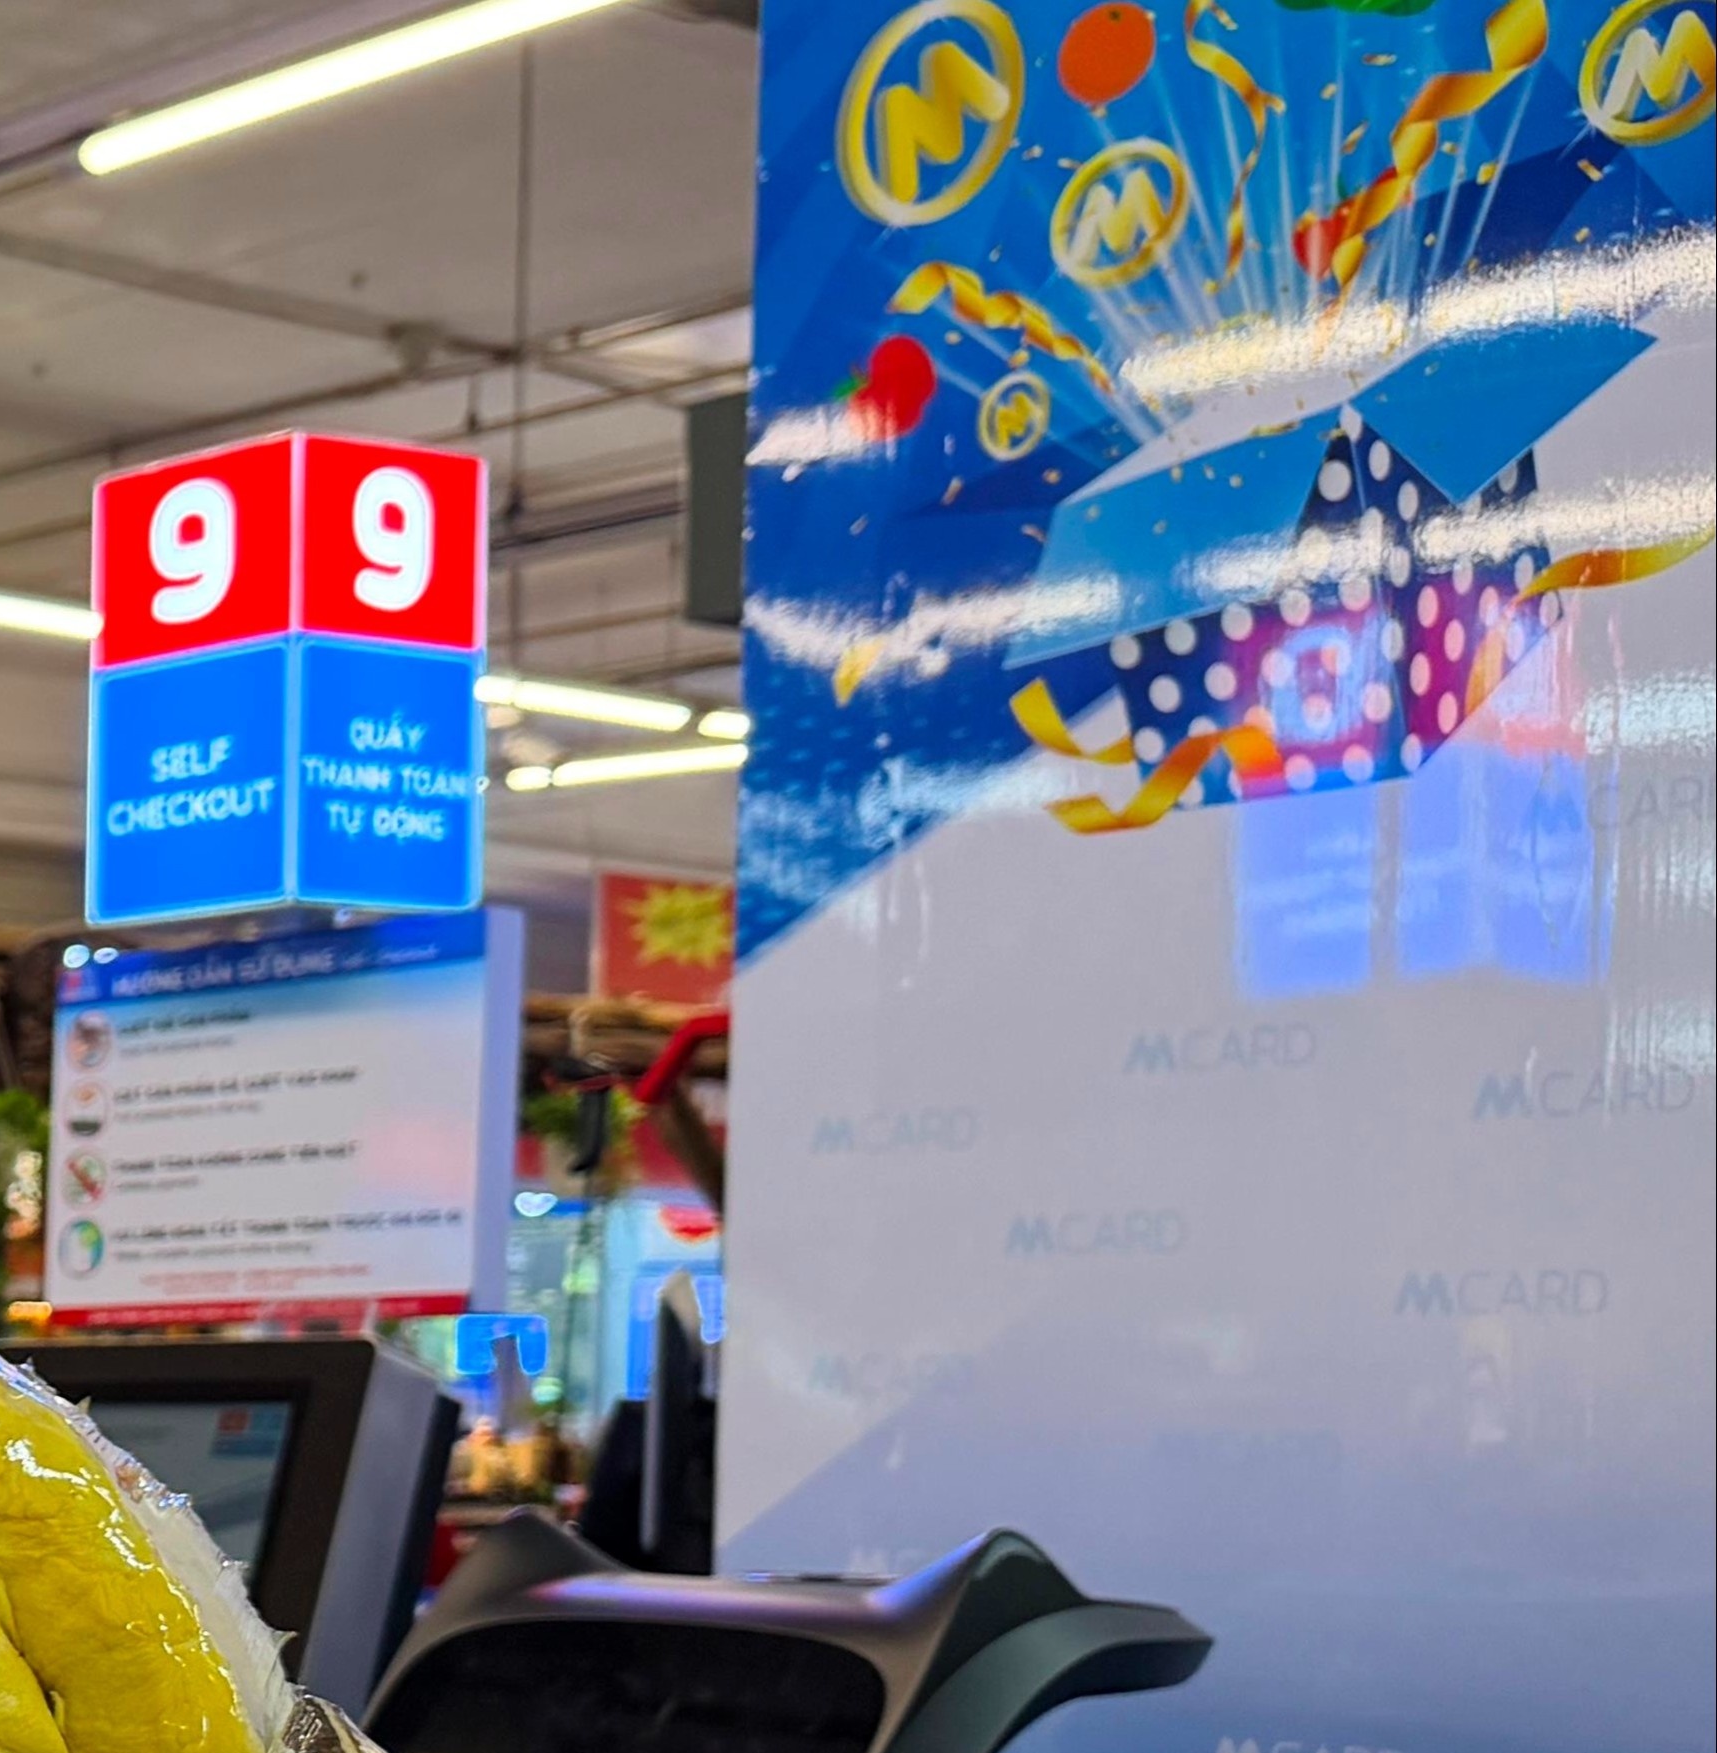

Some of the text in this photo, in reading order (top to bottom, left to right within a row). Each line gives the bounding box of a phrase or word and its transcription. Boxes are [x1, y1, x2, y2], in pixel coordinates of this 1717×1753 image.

[148, 477, 235, 625] 9
[352, 466, 435, 612] 9
[150, 734, 233, 783] SELF
[106, 776, 277, 837] CHECKOUT
[1470, 1066, 1696, 1121] MCARD
[1392, 1268, 1610, 1318] MCARD
